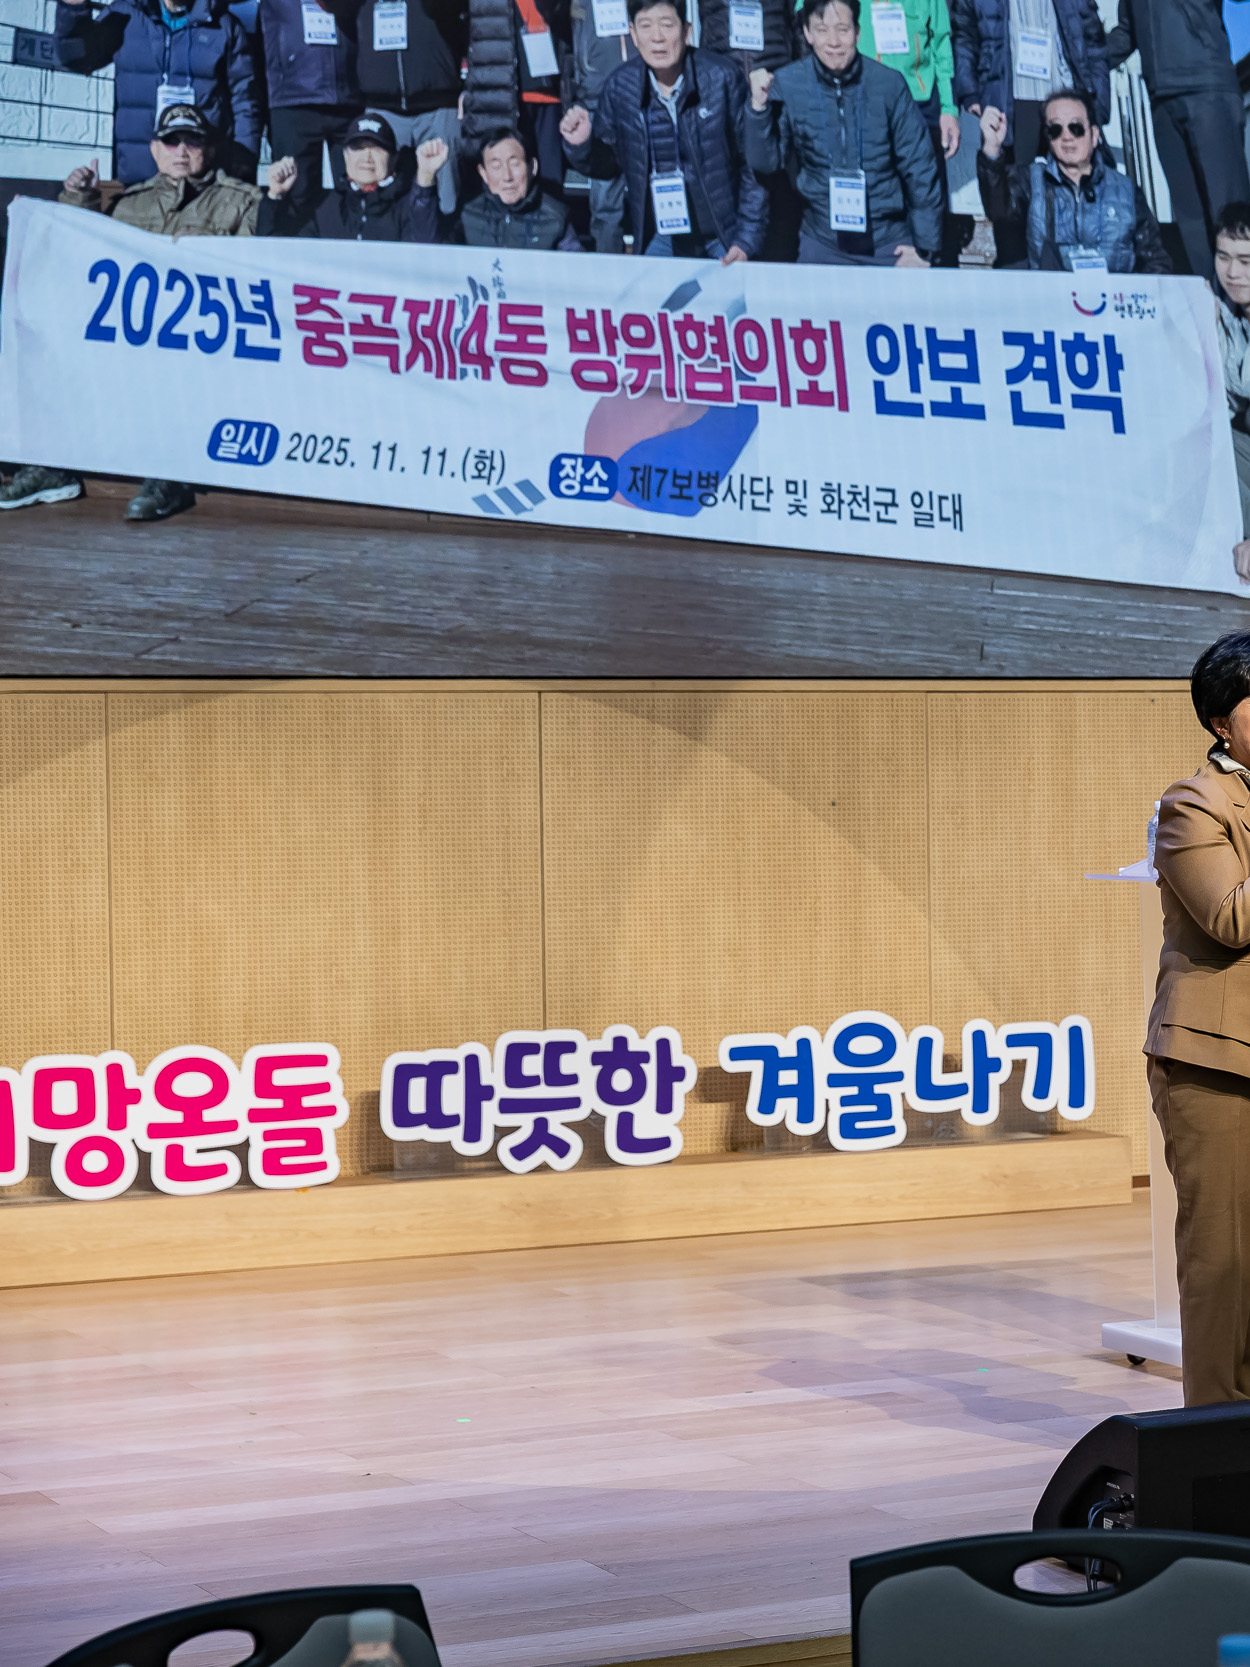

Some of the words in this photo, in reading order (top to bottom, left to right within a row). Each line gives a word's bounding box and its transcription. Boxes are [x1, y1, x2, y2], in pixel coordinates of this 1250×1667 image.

[85, 259, 281, 362] 2025년
[293, 284, 549, 388] 중곡제4동
[566, 308, 849, 412] 방위협의회
[866, 323, 986, 421] 안보
[1002, 331, 1126, 435] 견학
[217, 422, 272, 463] 일시
[286, 432, 355, 467] 2025.
[372, 441, 405, 473] 11.
[558, 457, 609, 496] 장소
[628, 464, 773, 513] 제7보병사단
[785, 479, 808, 517] 및
[820, 482, 899, 524] 화천군
[911, 489, 964, 531] 일대
[392, 1035, 686, 1163] 따뜻한
[728, 1021, 1086, 1140] 겨울나기
